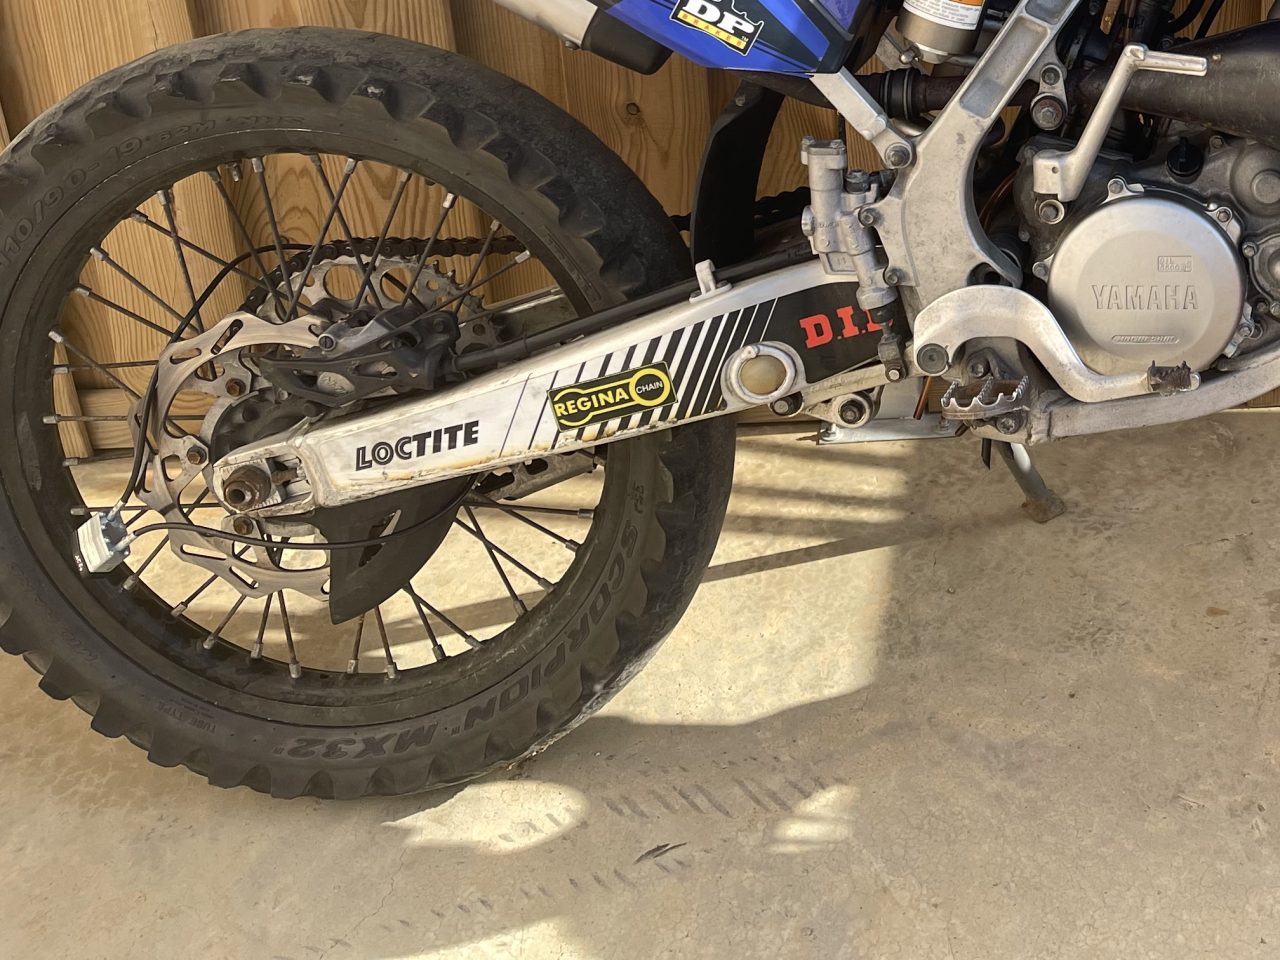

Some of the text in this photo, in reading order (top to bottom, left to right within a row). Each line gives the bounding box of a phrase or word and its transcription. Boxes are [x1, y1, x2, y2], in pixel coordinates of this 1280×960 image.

[682, 13, 743, 47] BRAKES
[1091, 284, 1200, 310] YAMAHA
[554, 380, 663, 418] REGINA CHAIN
[355, 420, 480, 472] LOCTITE
